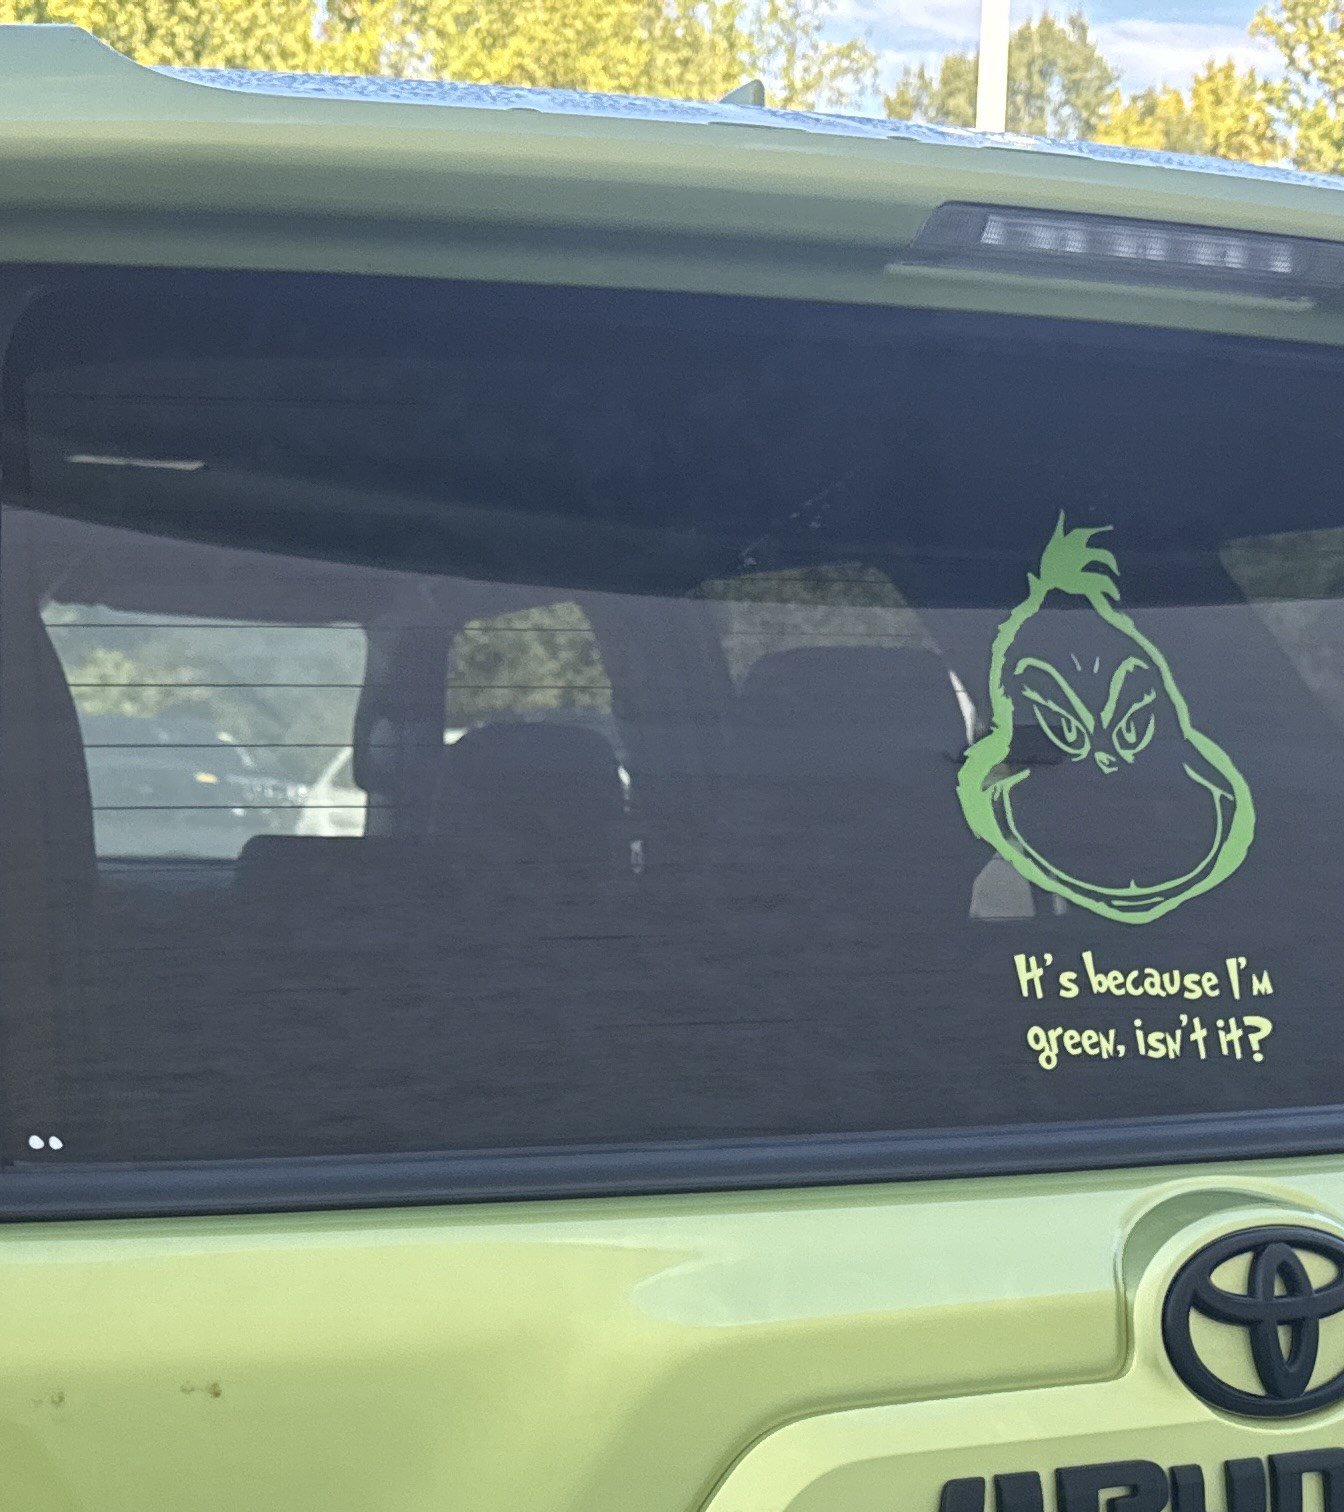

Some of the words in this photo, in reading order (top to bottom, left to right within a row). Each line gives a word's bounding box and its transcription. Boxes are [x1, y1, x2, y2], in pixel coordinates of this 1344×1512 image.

[1014, 951, 1079, 1000] It's
[1082, 951, 1220, 999] because
[1215, 1015, 1273, 1063] it?
